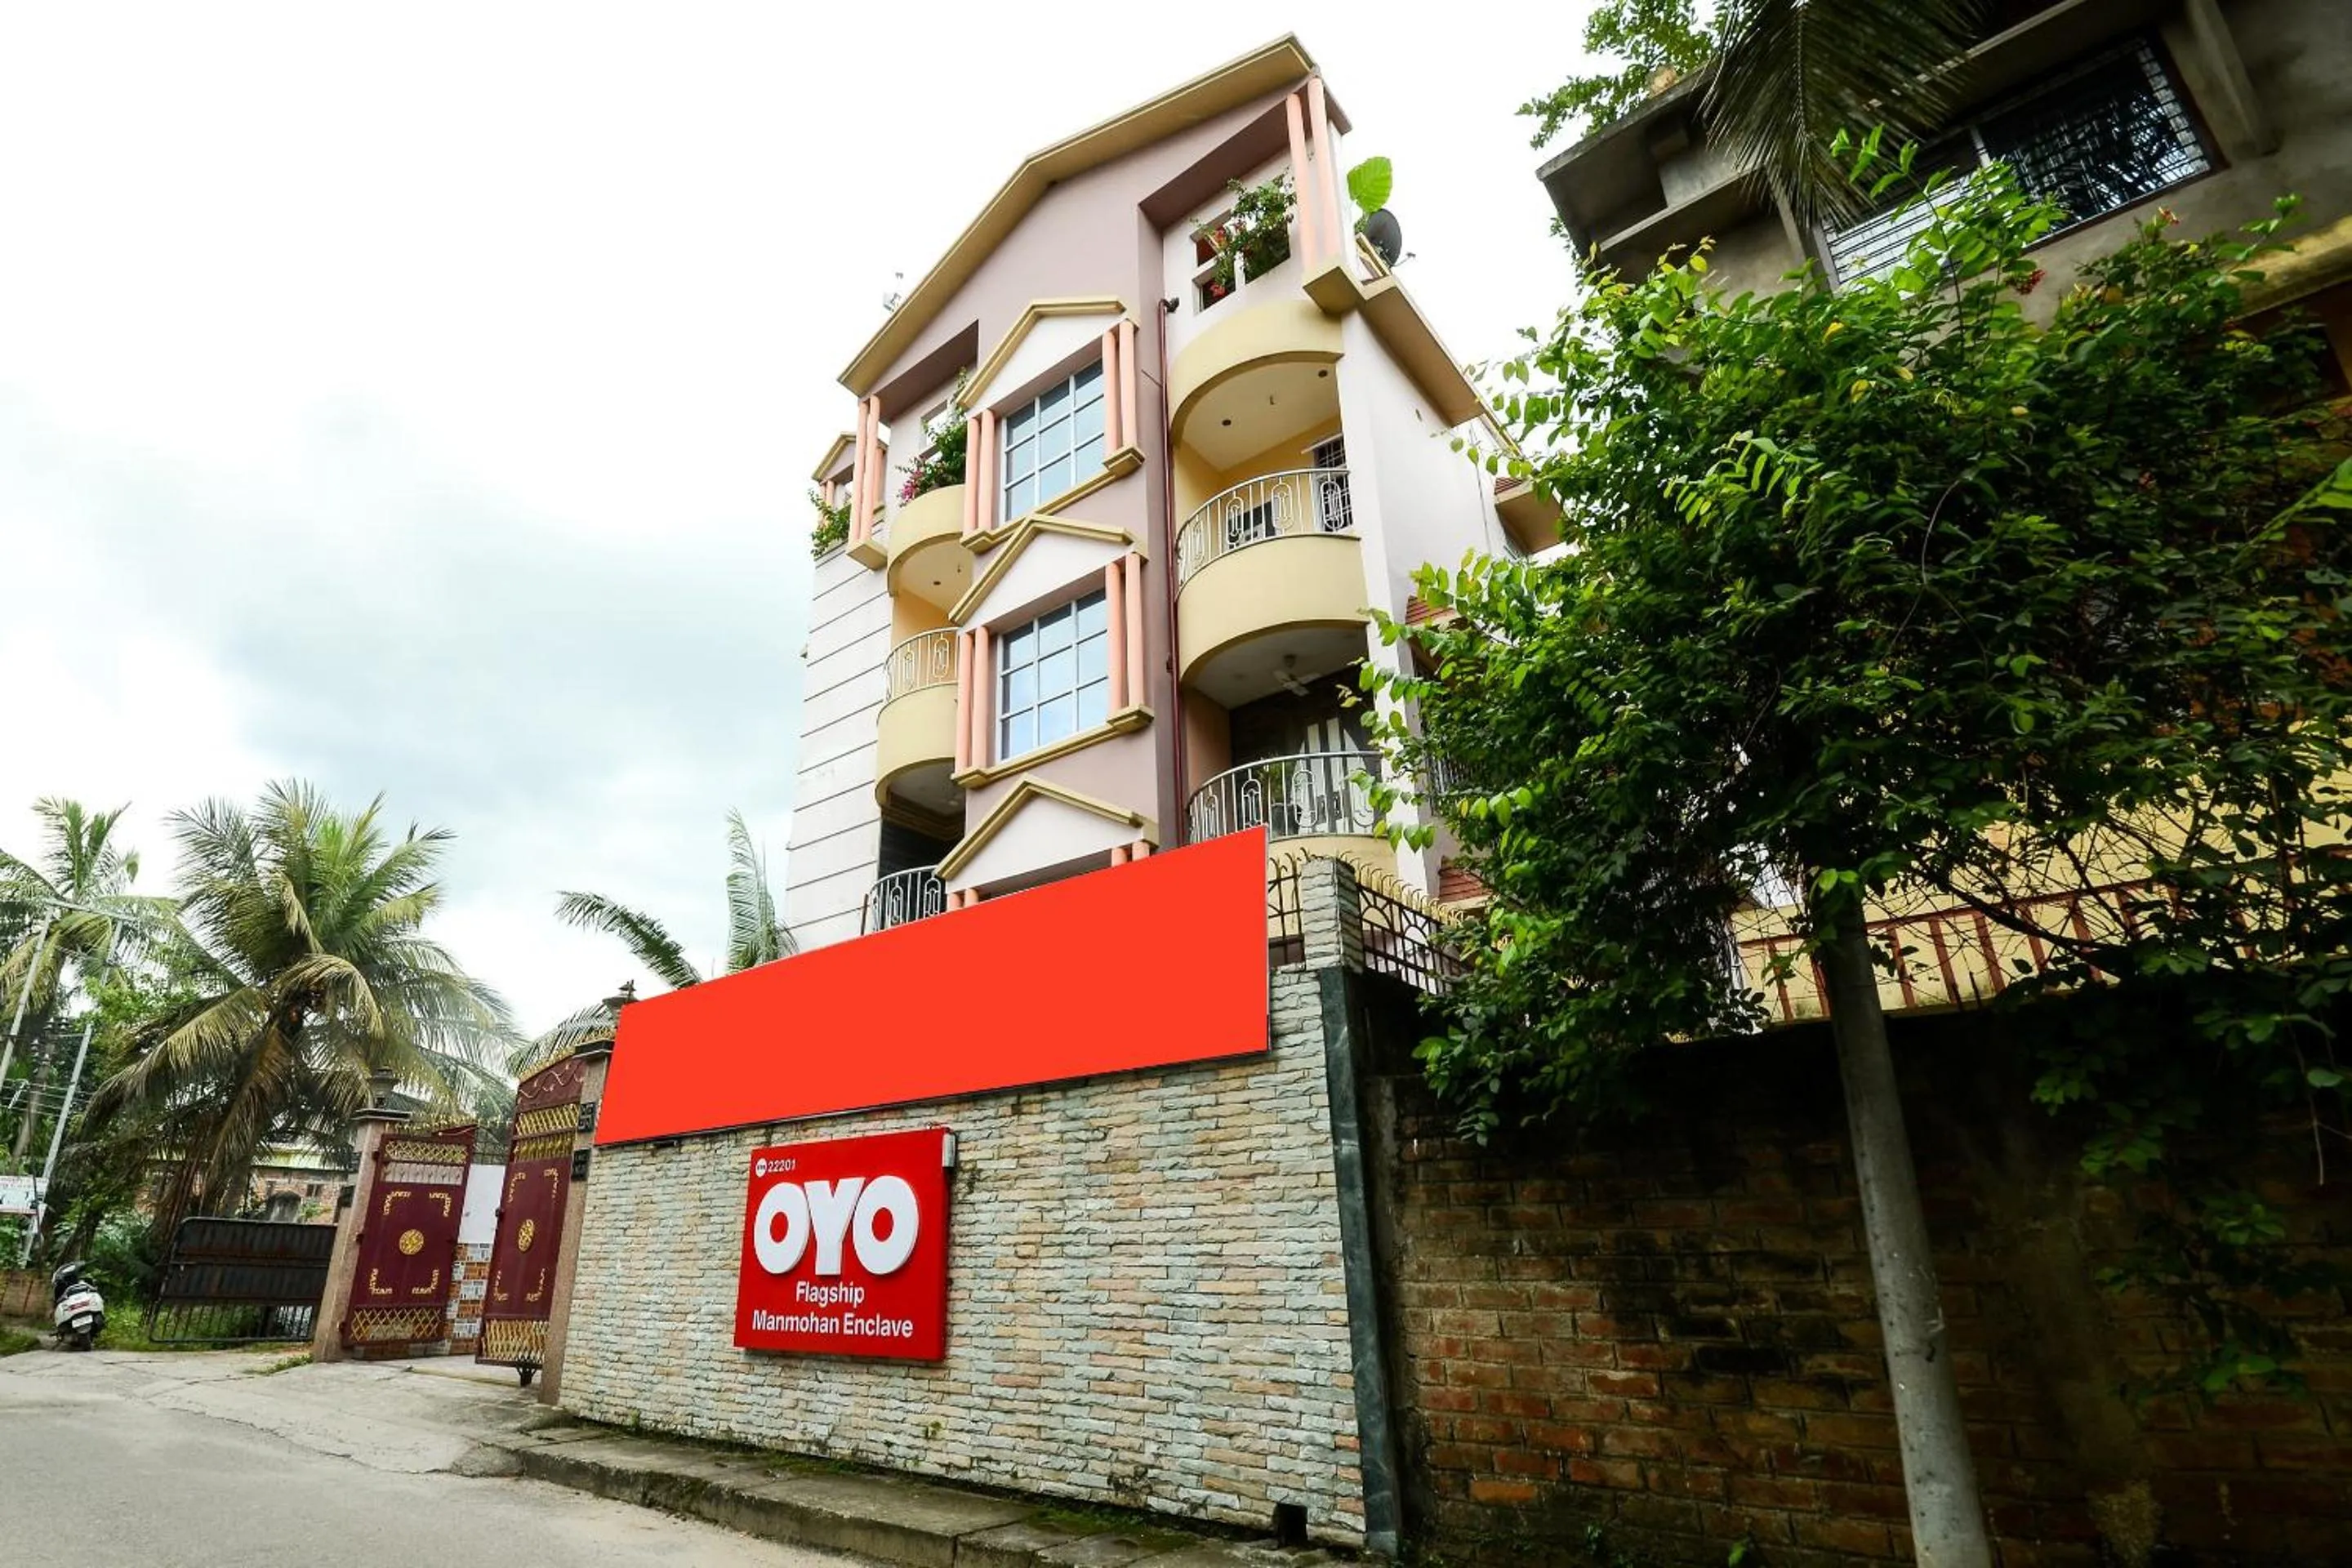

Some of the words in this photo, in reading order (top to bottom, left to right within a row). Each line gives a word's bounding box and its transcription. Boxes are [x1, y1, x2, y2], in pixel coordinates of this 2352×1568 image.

[754, 1175, 919, 1275] OYO
[795, 1281, 865, 1308] Flagship
[752, 1309, 840, 1334] Manmohan
[843, 1312, 914, 1338] Enclave
